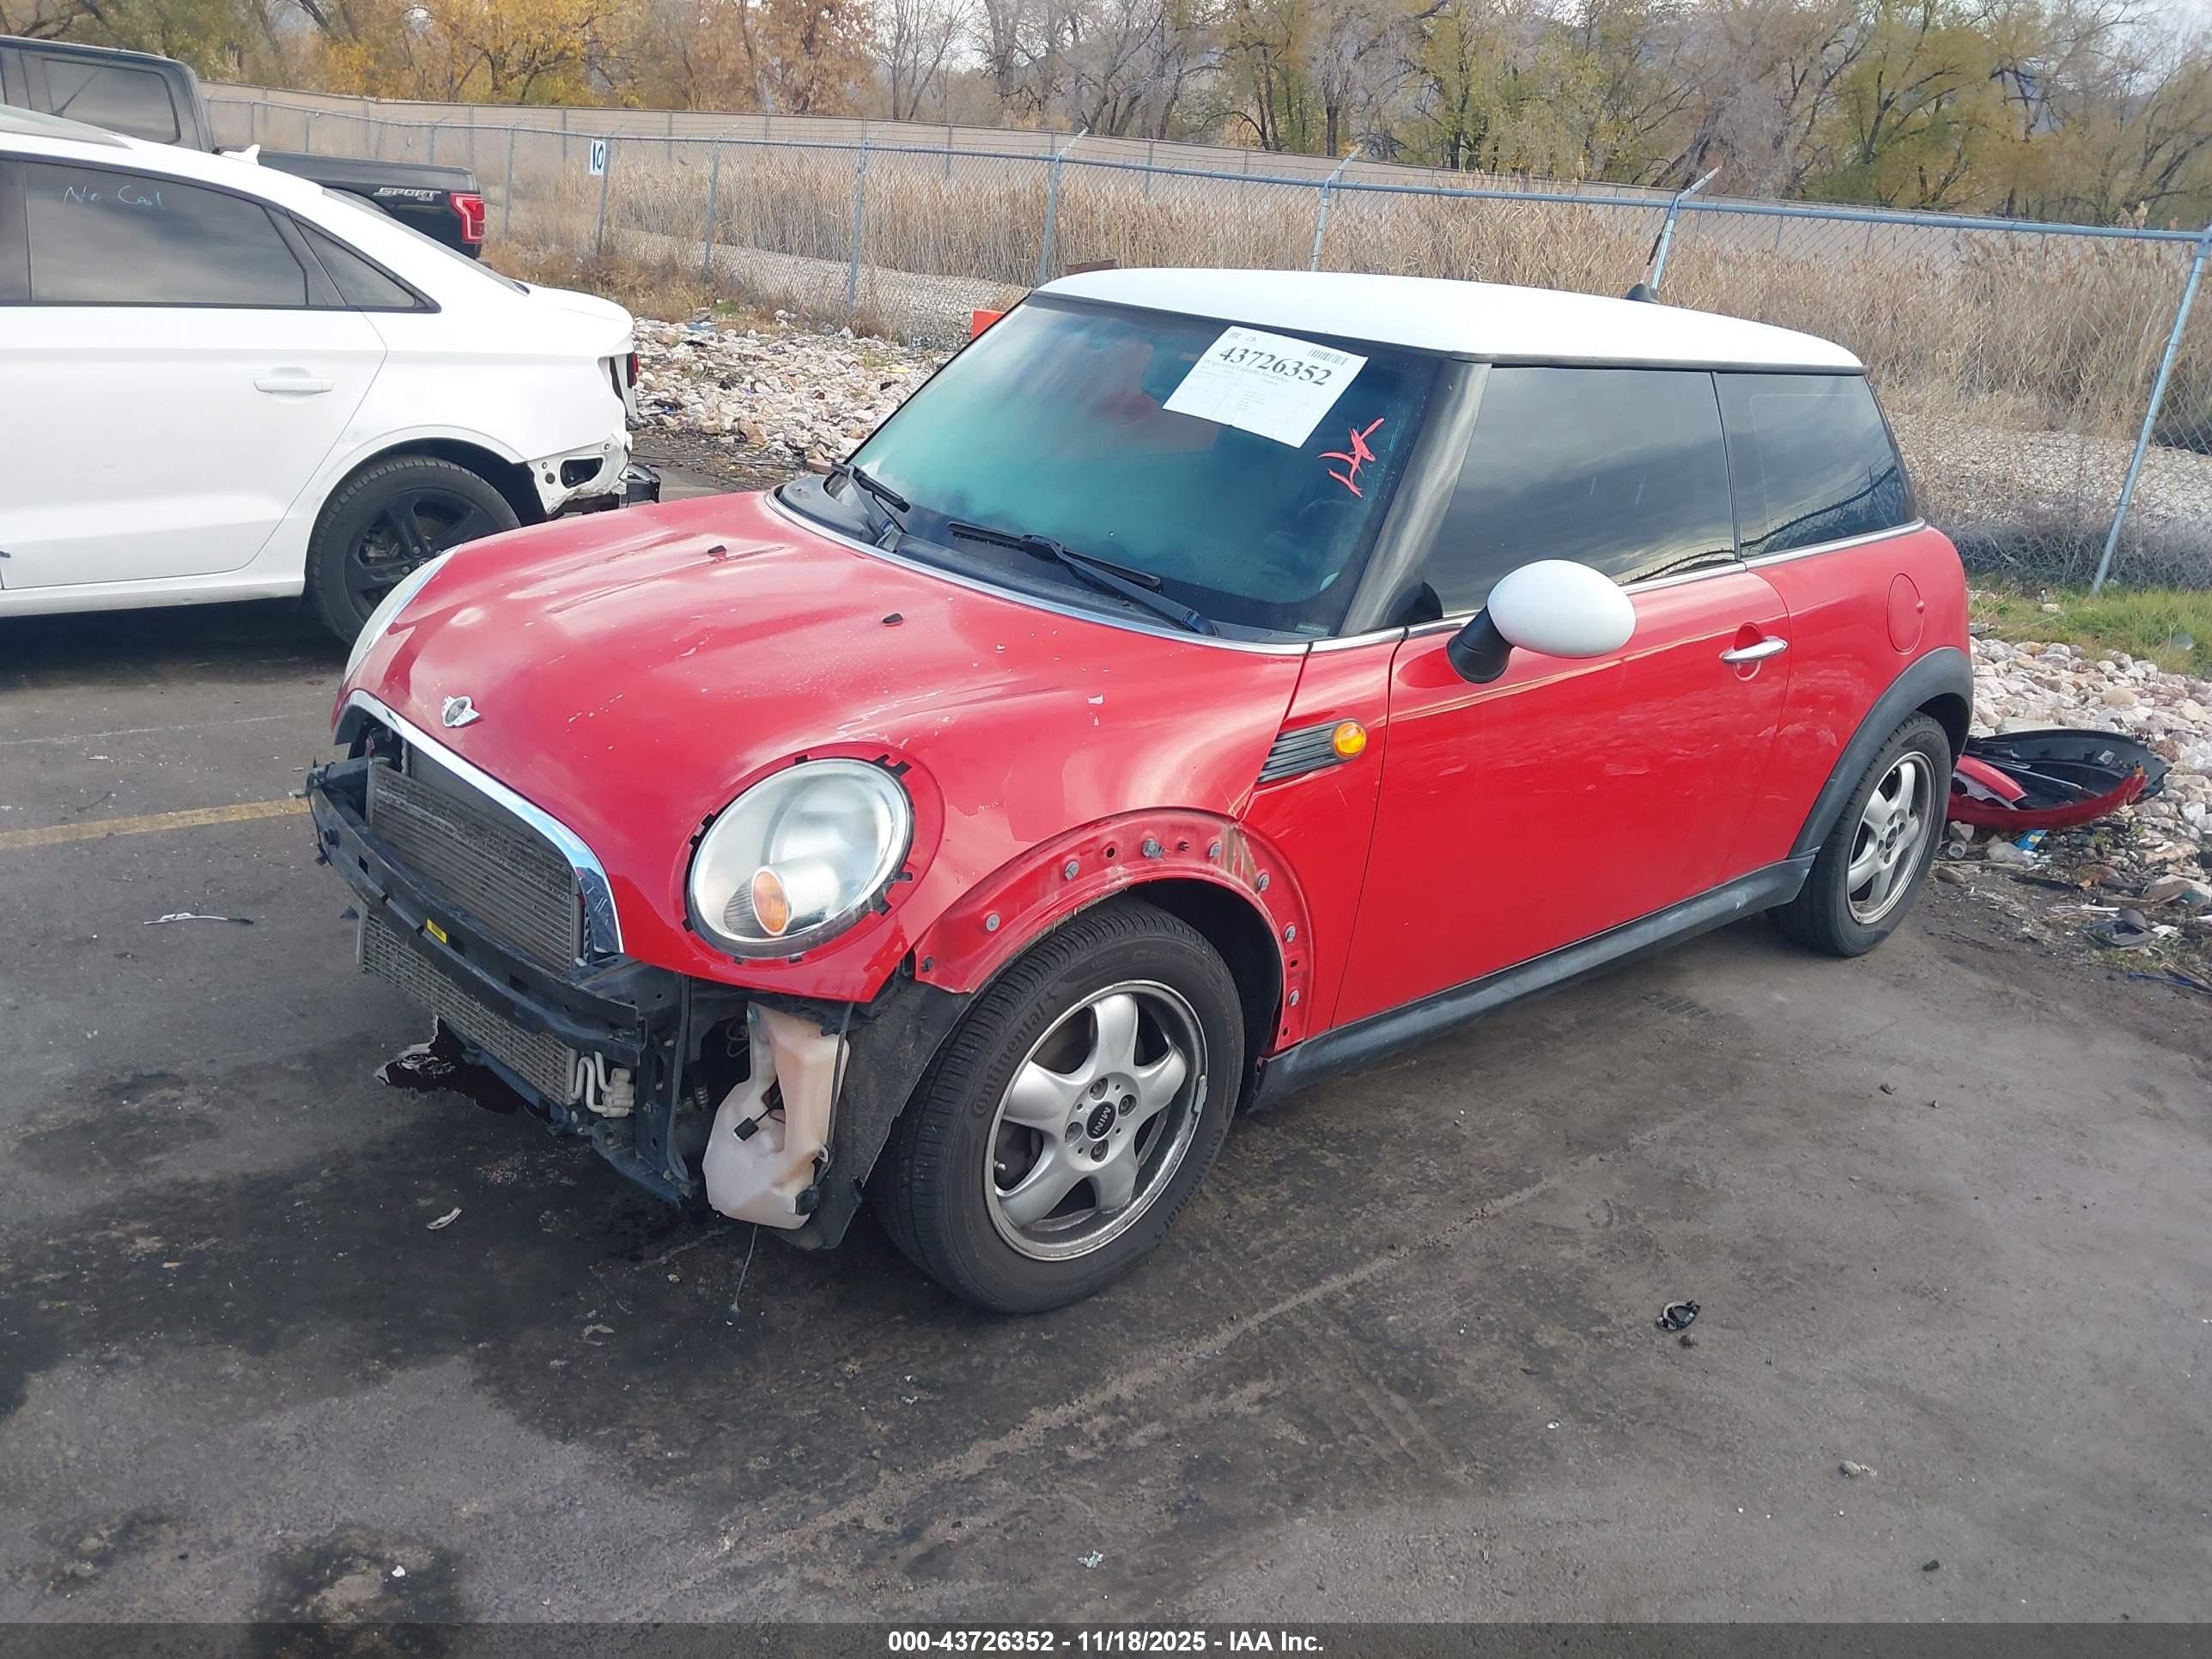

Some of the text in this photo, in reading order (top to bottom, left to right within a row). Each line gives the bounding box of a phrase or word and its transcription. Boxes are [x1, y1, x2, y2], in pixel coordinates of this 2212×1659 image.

[592, 142, 605, 171] 10
[374, 187, 442, 198] SPORT
[1219, 346, 1332, 386] 43726352
[1091, 1107, 1111, 1135] MINI
